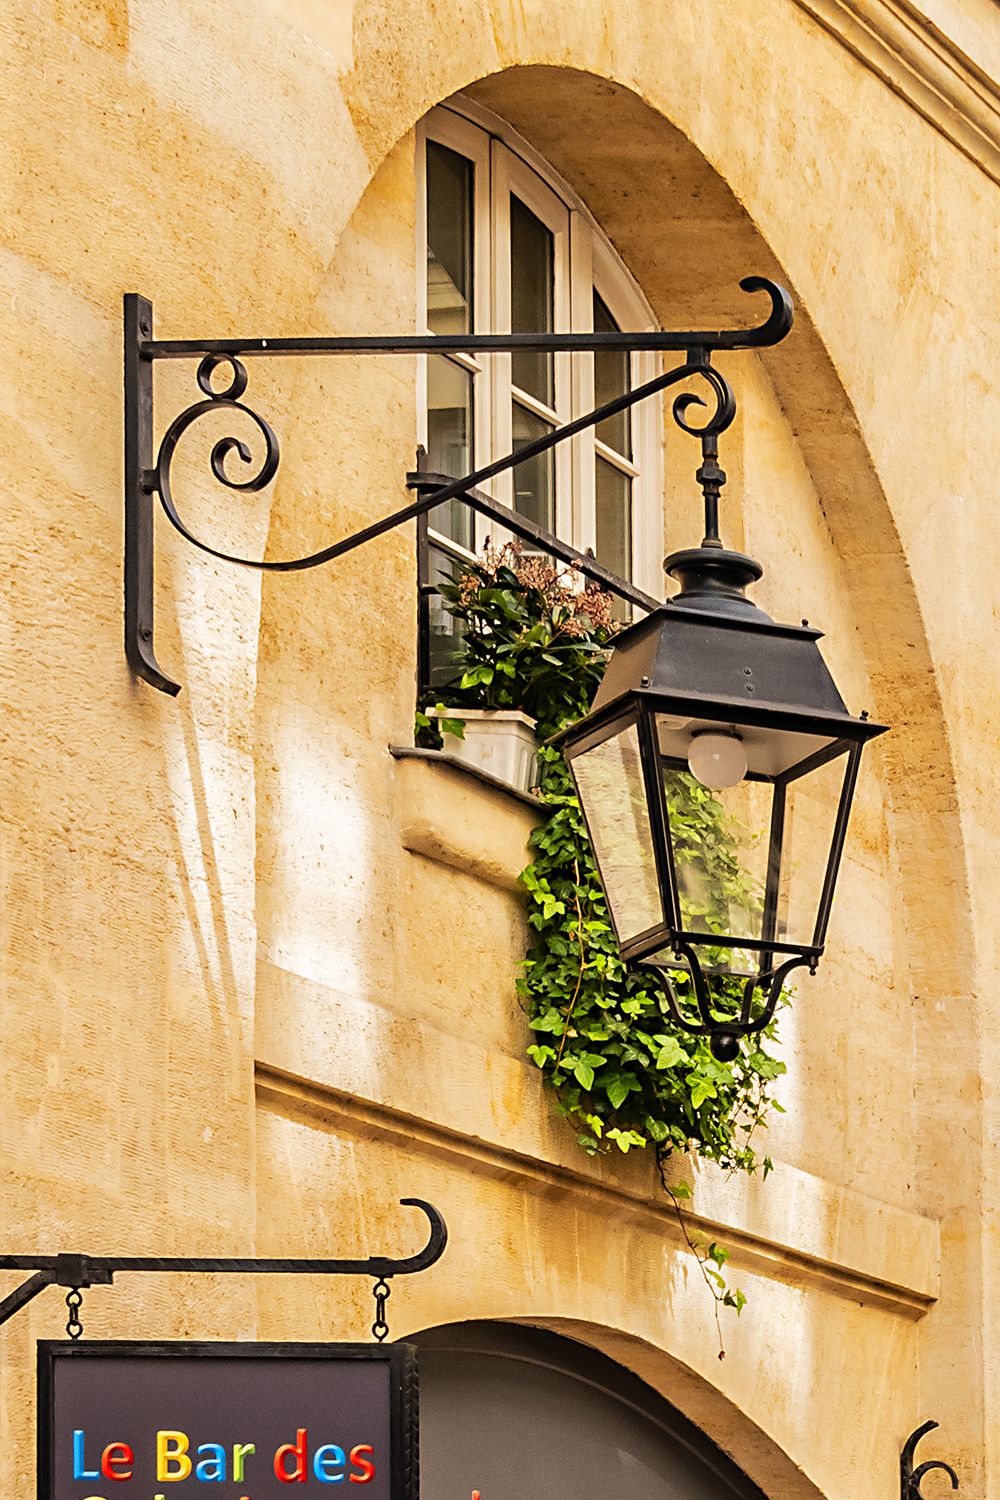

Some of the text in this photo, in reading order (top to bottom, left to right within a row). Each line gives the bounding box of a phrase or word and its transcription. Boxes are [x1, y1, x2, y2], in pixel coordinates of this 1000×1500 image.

[73, 1428, 376, 1485] Le Bar des
